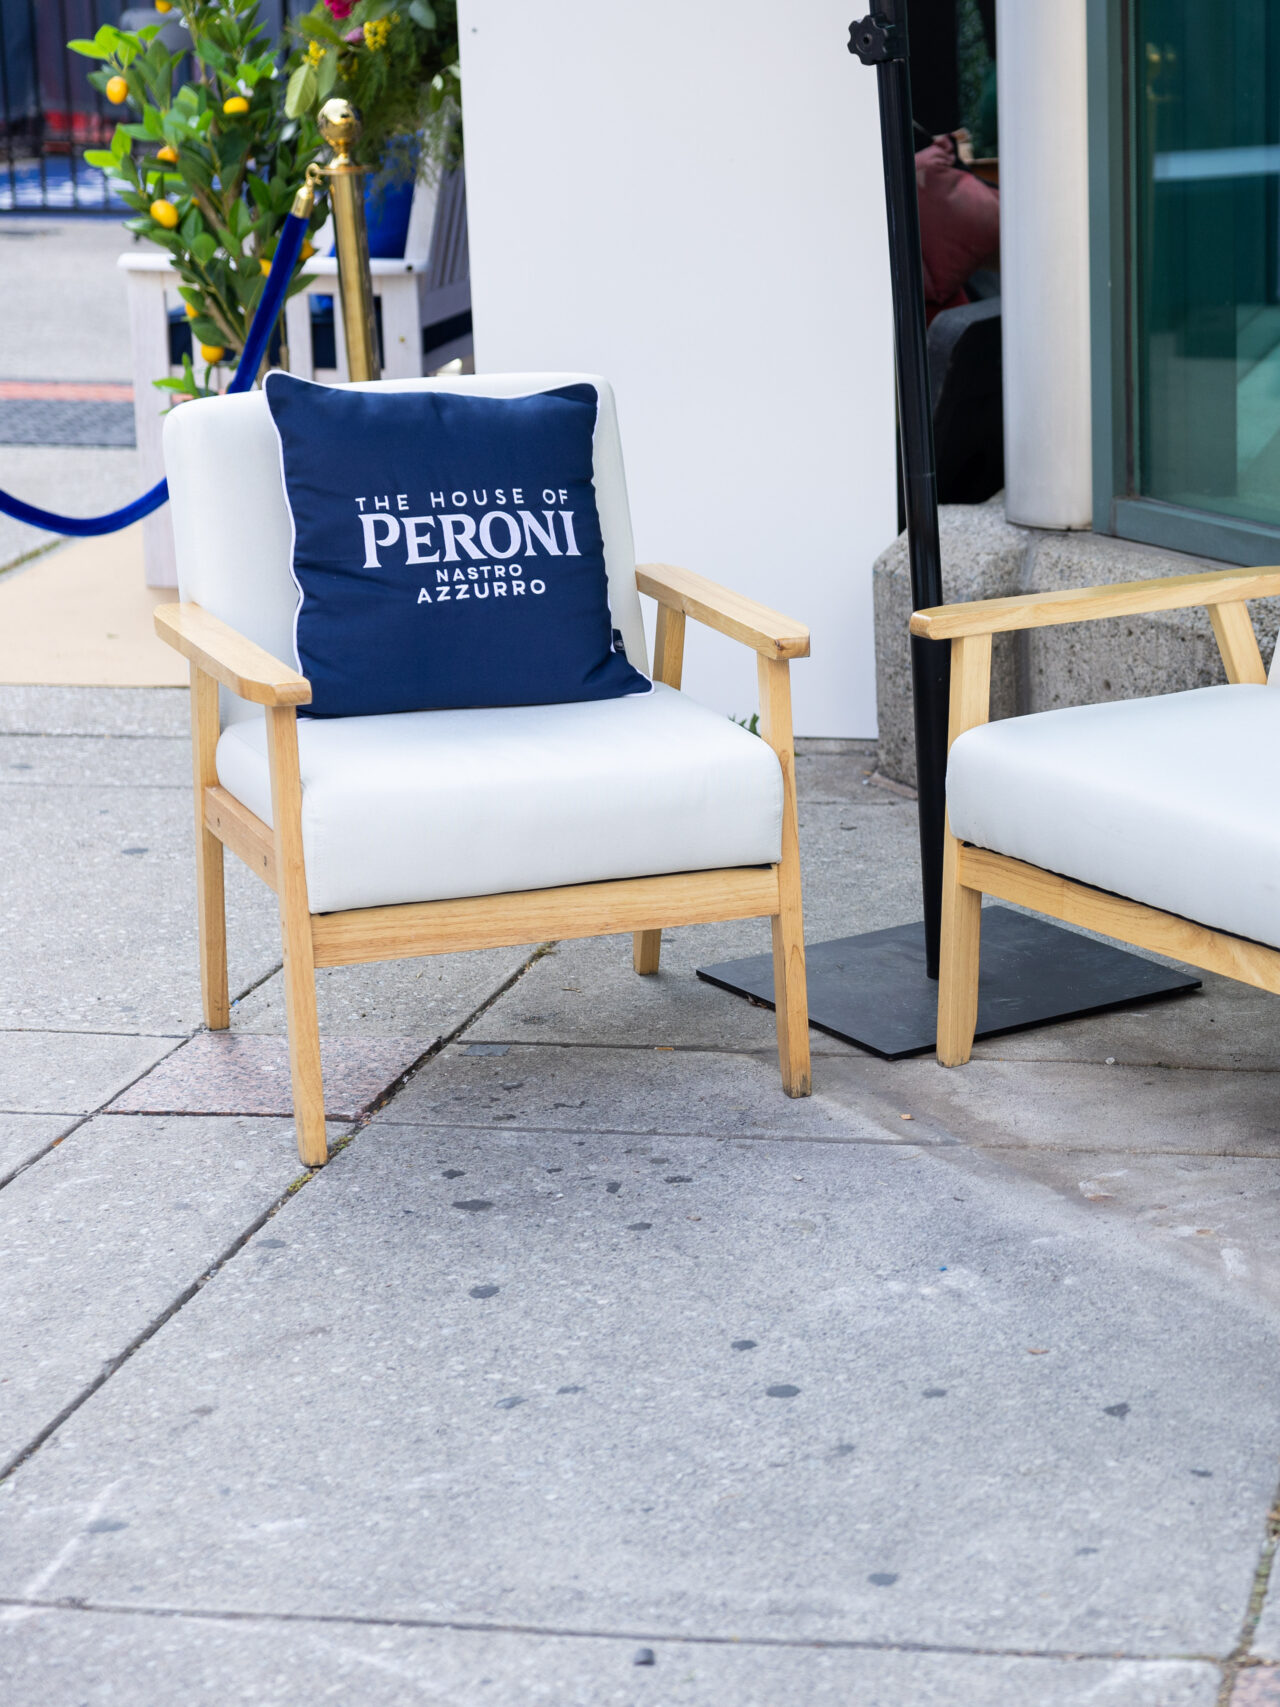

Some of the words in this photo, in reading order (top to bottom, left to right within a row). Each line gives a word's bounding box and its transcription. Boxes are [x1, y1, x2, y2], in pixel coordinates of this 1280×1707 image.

[355, 494, 410, 511] THE
[430, 488, 525, 509] HOUSE
[542, 489, 569, 505] OF
[358, 510, 582, 569] PERONI
[436, 563, 523, 583] NASTRO
[417, 579, 546, 604] AZZURRO
